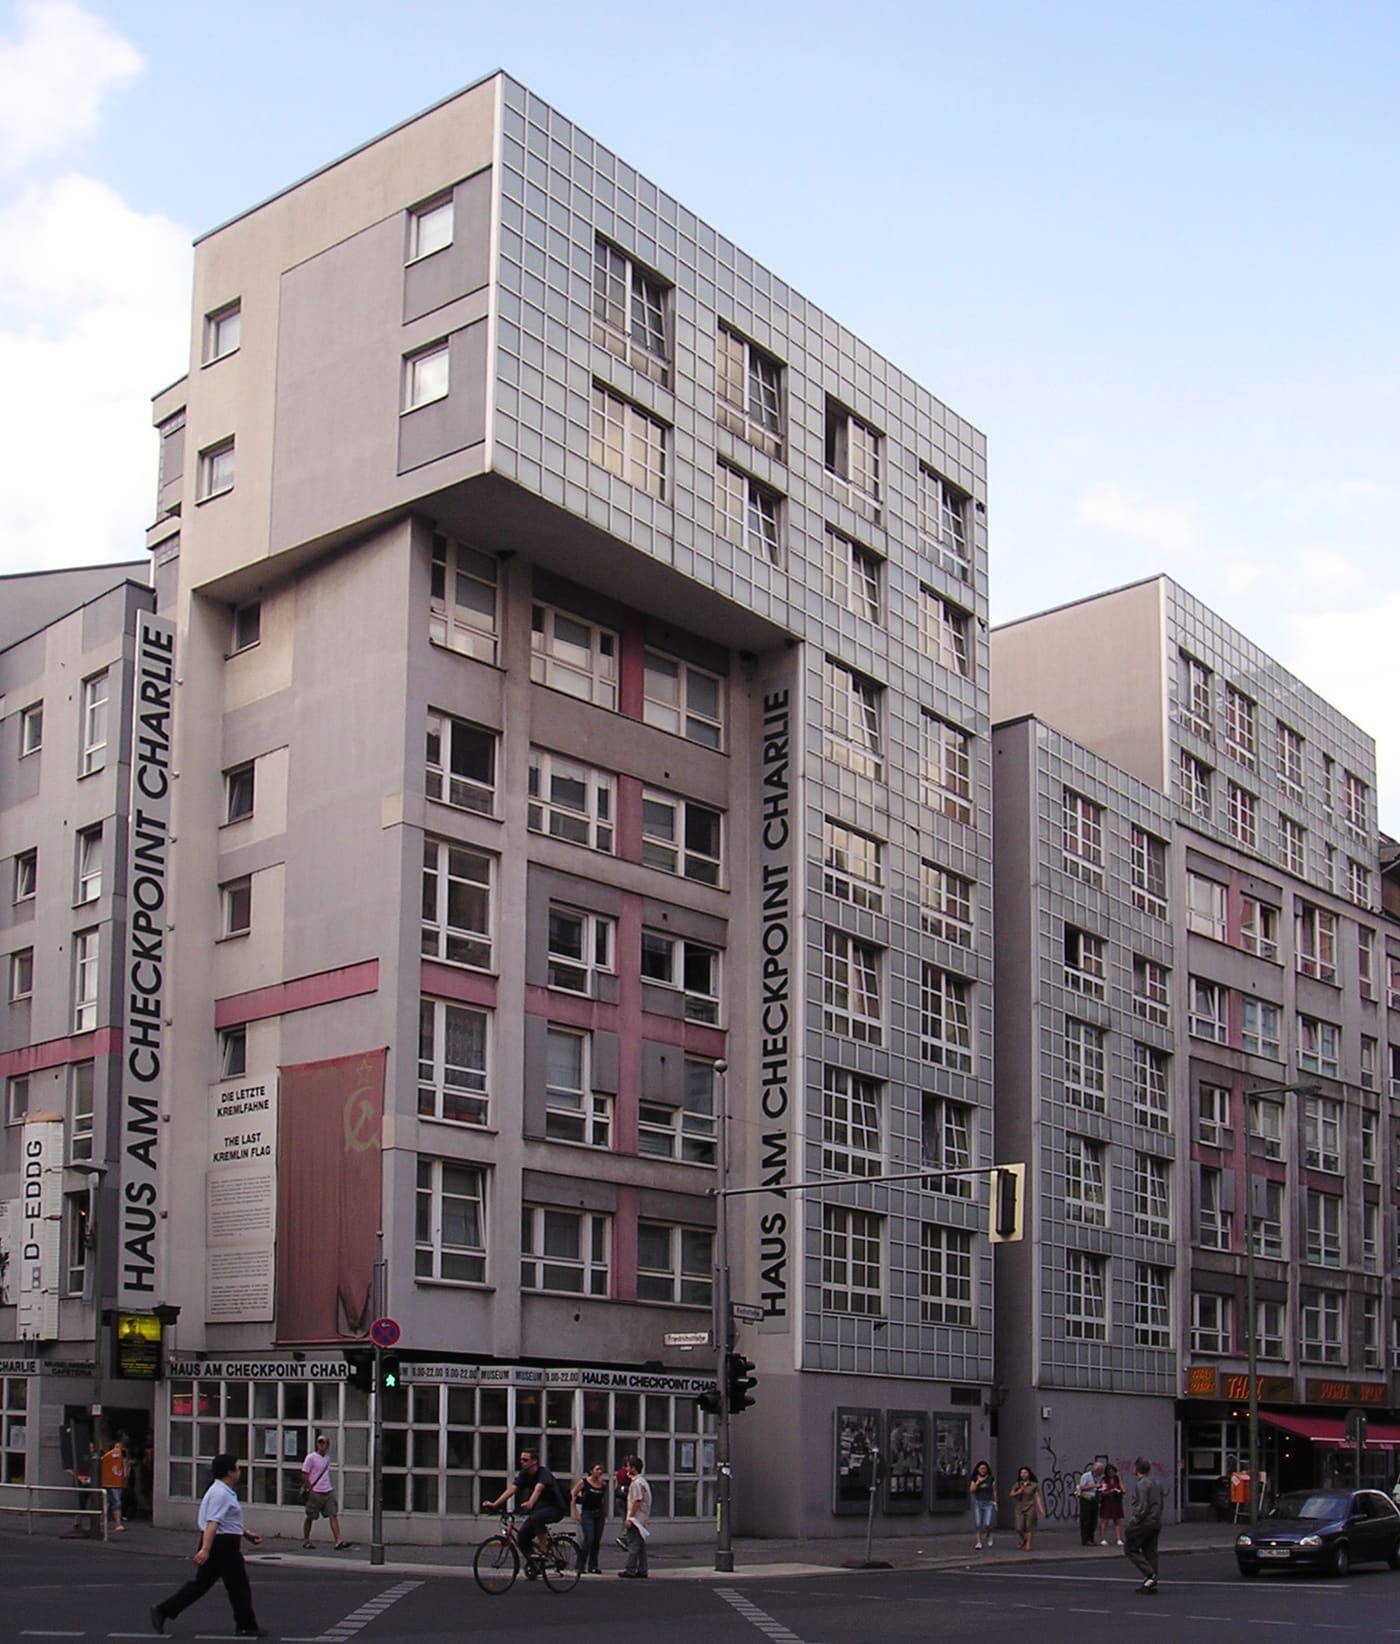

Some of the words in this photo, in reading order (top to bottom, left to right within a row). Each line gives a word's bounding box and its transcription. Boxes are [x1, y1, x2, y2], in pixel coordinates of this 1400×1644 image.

[136, 625, 173, 800] CHARLIE
[762, 688, 789, 851] CHARLIE
[128, 809, 167, 1082] CHECKPOINT
[761, 865, 789, 1119] CHECKPOINT
[216, 1099, 270, 1118] KREMLFAHNE
[221, 1091, 235, 1103] DIE
[235, 1086, 266, 1101] LETZTE
[126, 1096, 159, 1170] AM
[212, 1148, 249, 1163] KREMLIN
[250, 1145, 272, 1158] FLAG
[223, 1135, 239, 1148] THE
[241, 1132, 262, 1145] LAST
[761, 1132, 788, 1199] AM
[24, 1140, 43, 1260] D-EDDG
[123, 1182, 157, 1291] HAUS
[760, 1213, 788, 1316] HAUS
[169, 1363, 202, 1377] HAUS
[204, 1363, 223, 1377] AM
[225, 1363, 307, 1377] CHECKPOINT
[310, 1363, 347, 1378] CHAR
[480, 1369, 510, 1380] MUSEUM
[515, 1371, 543, 1382] MUSEUM
[581, 1372, 610, 1385] HAUS
[611, 1375, 628, 1386] AM
[629, 1375, 690, 1391] CHECKPOINT
[691, 1379, 718, 1392] CHAR
